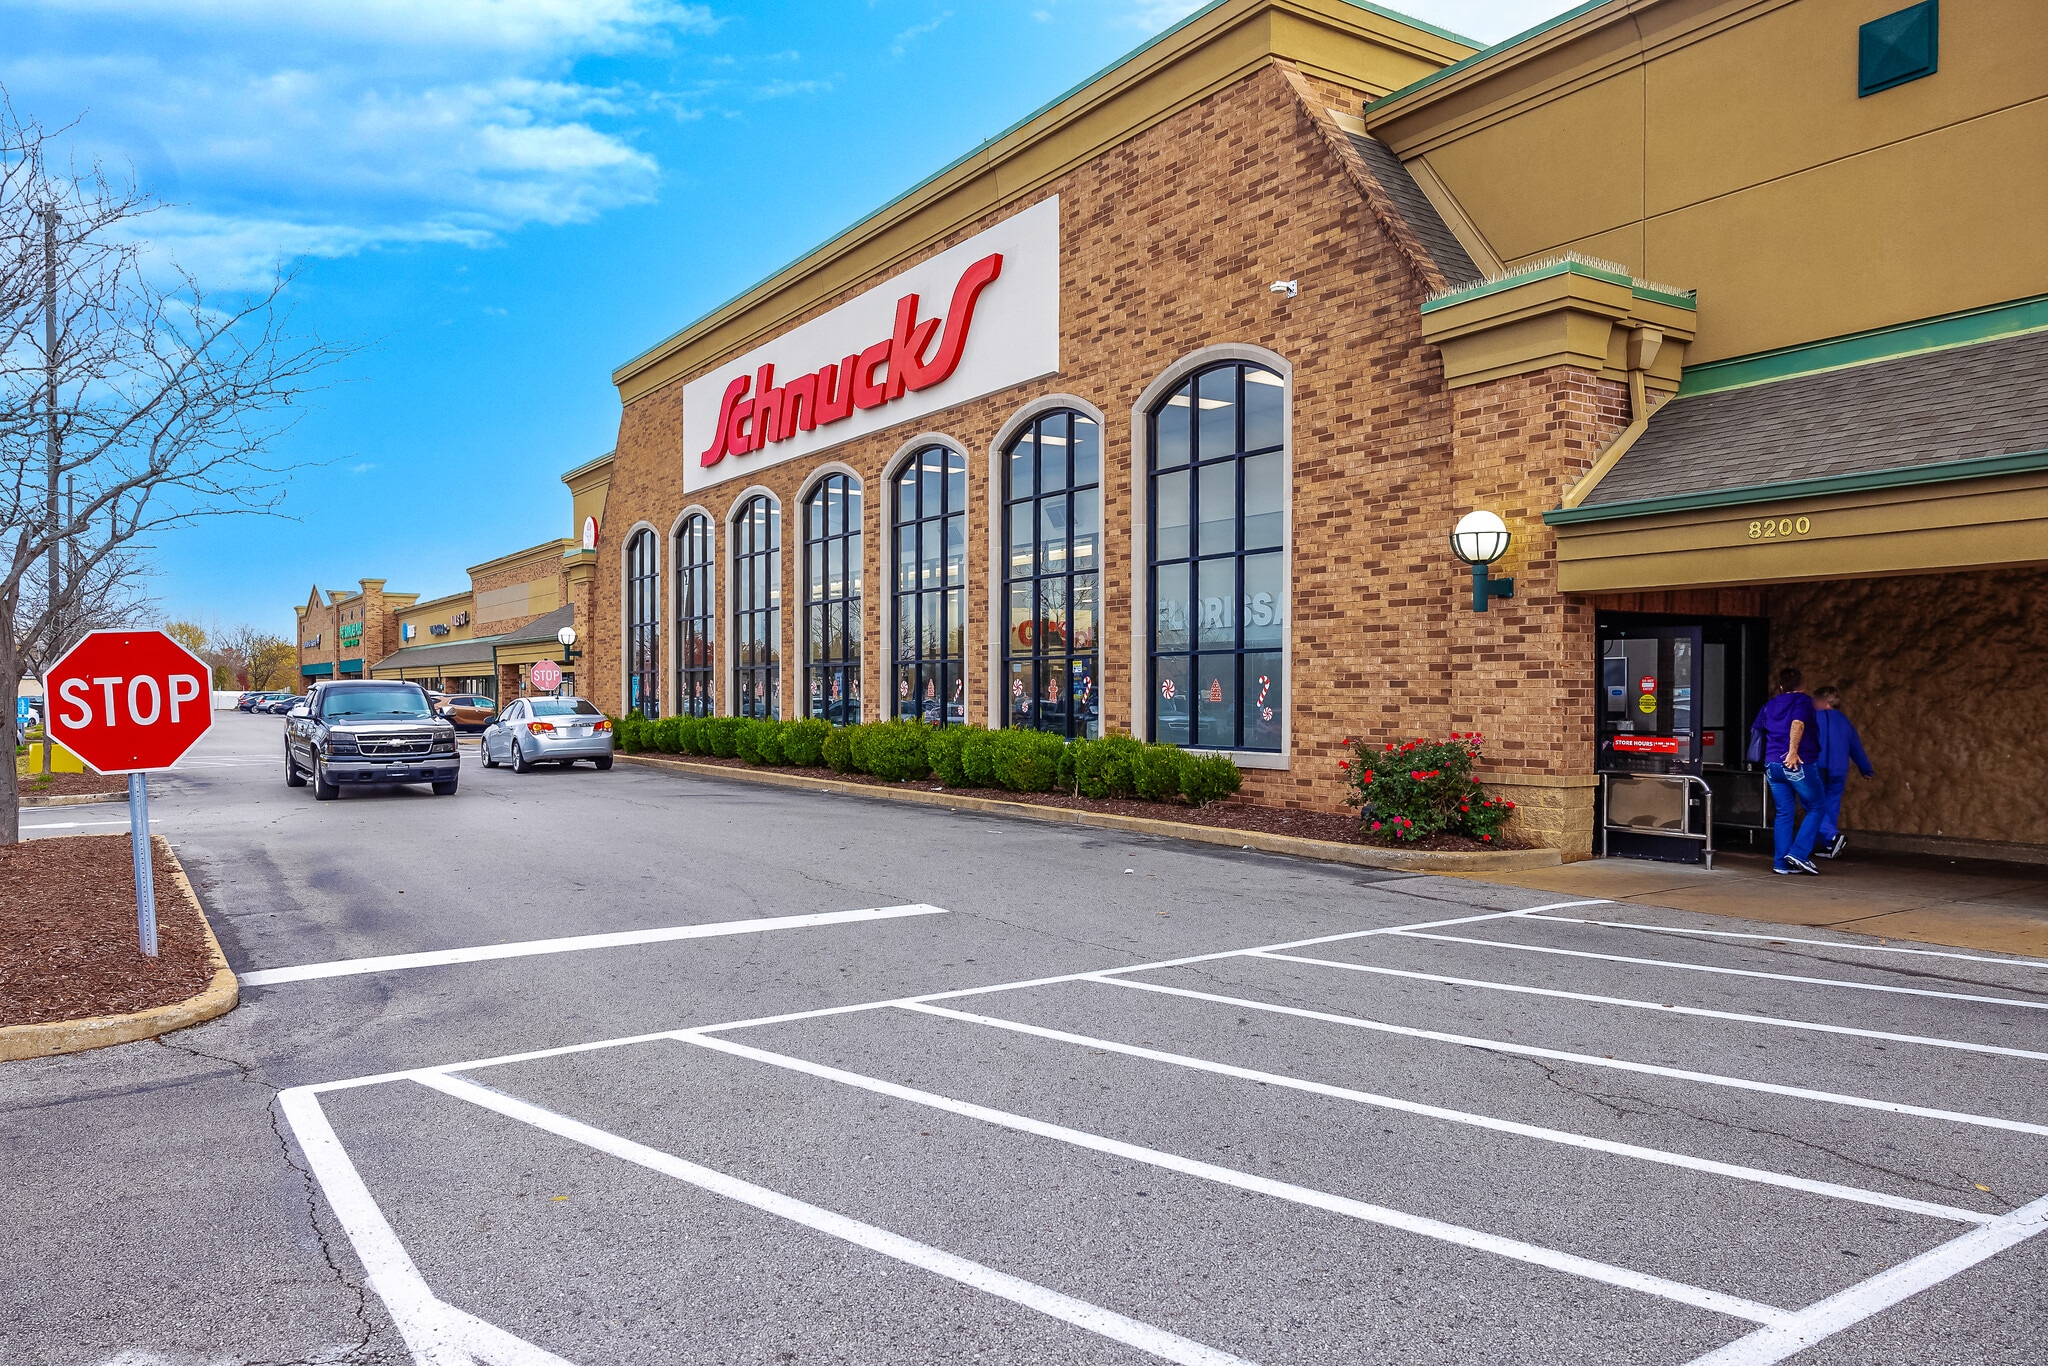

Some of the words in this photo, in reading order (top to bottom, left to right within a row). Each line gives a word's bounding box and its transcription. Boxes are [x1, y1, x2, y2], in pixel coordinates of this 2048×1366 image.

[700, 252, 1004, 468] Schnucks
[1748, 516, 1811, 539] 8200
[534, 670, 560, 681] STOP
[59, 674, 200, 729] STOP
